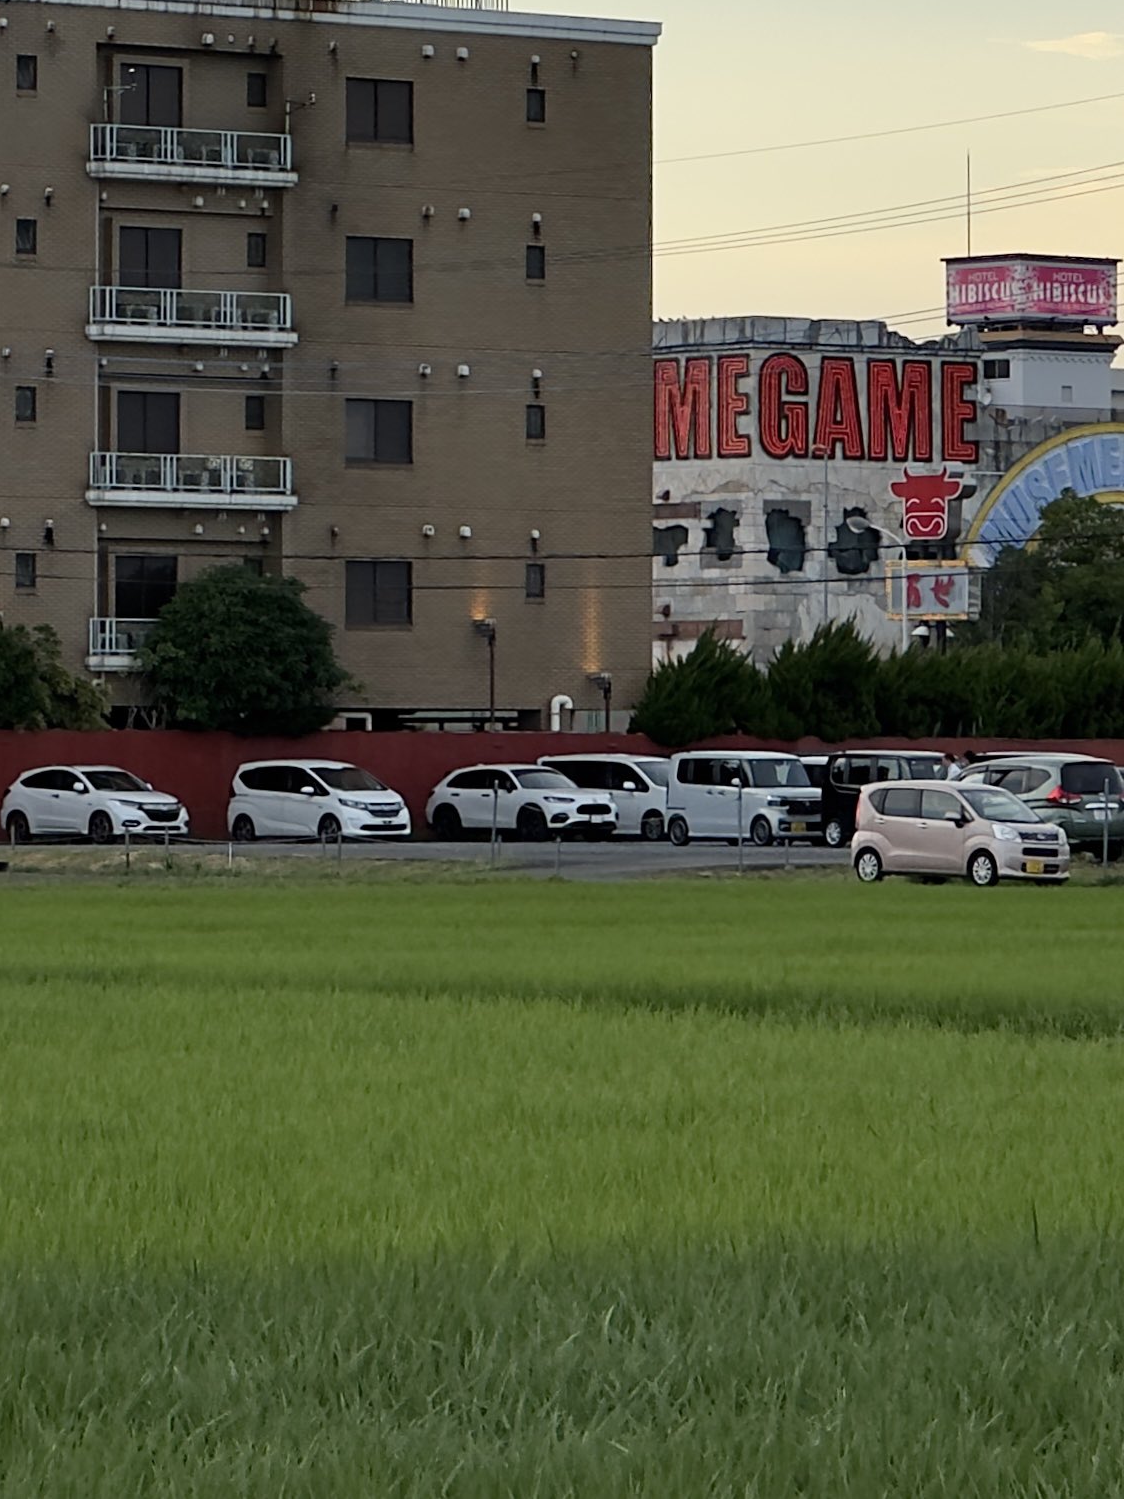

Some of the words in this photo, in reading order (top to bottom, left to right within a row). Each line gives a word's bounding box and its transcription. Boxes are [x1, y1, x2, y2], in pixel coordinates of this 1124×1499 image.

[968, 271, 999, 281] HOTEL
[1053, 272, 1084, 283] HOTEL
[1032, 282, 1105, 304] HIBISCUS
[654, 353, 979, 463] MEGAME
